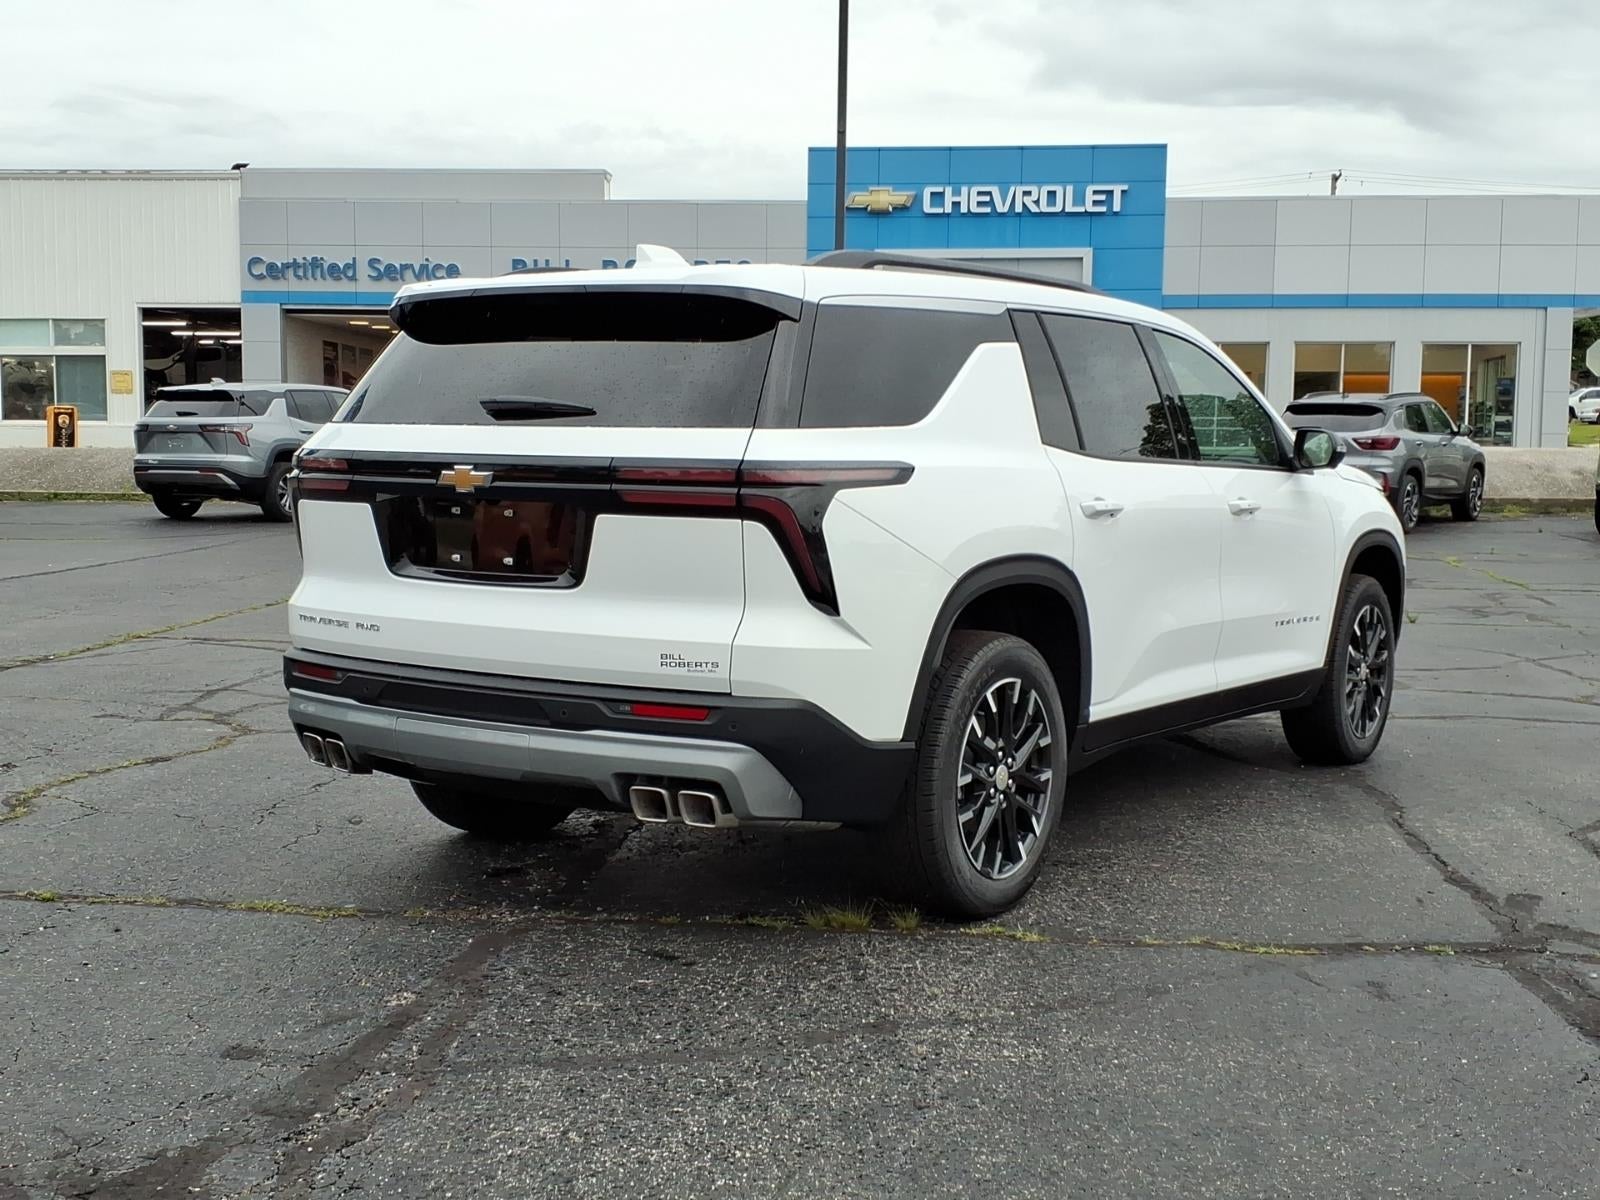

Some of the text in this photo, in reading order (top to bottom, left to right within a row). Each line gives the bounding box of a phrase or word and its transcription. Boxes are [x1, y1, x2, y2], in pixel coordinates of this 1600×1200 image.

[922, 184, 1129, 214] CHEVROLET
[246, 256, 462, 282] Certified Service
[660, 653, 685, 661] BILL
[660, 660, 719, 669] ROBERTS
